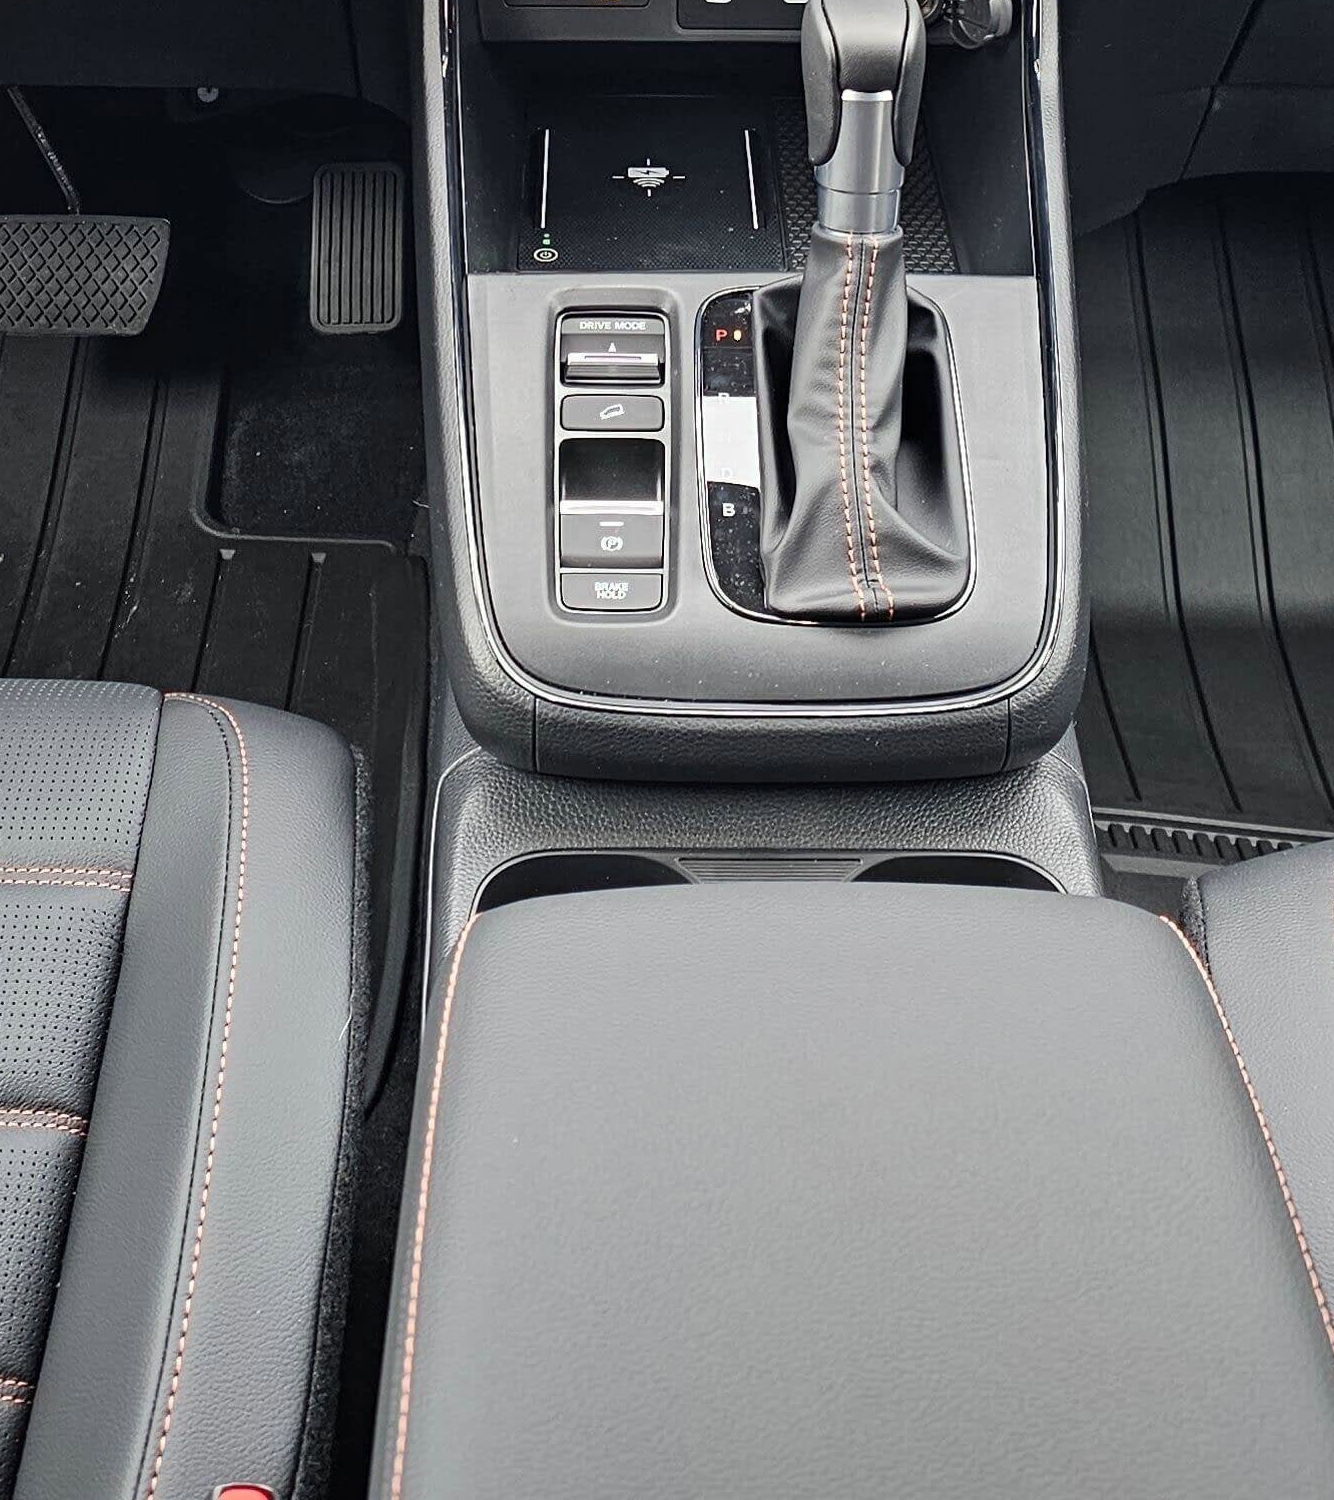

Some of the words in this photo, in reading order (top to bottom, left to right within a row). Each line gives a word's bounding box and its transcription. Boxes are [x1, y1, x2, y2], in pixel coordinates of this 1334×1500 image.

[579, 321, 612, 331] DRIVE
[615, 321, 646, 331] MODE
[716, 329, 727, 341] P
[722, 502, 736, 517] B
[594, 581, 628, 591] BRAKE
[596, 590, 626, 599] HOLD
